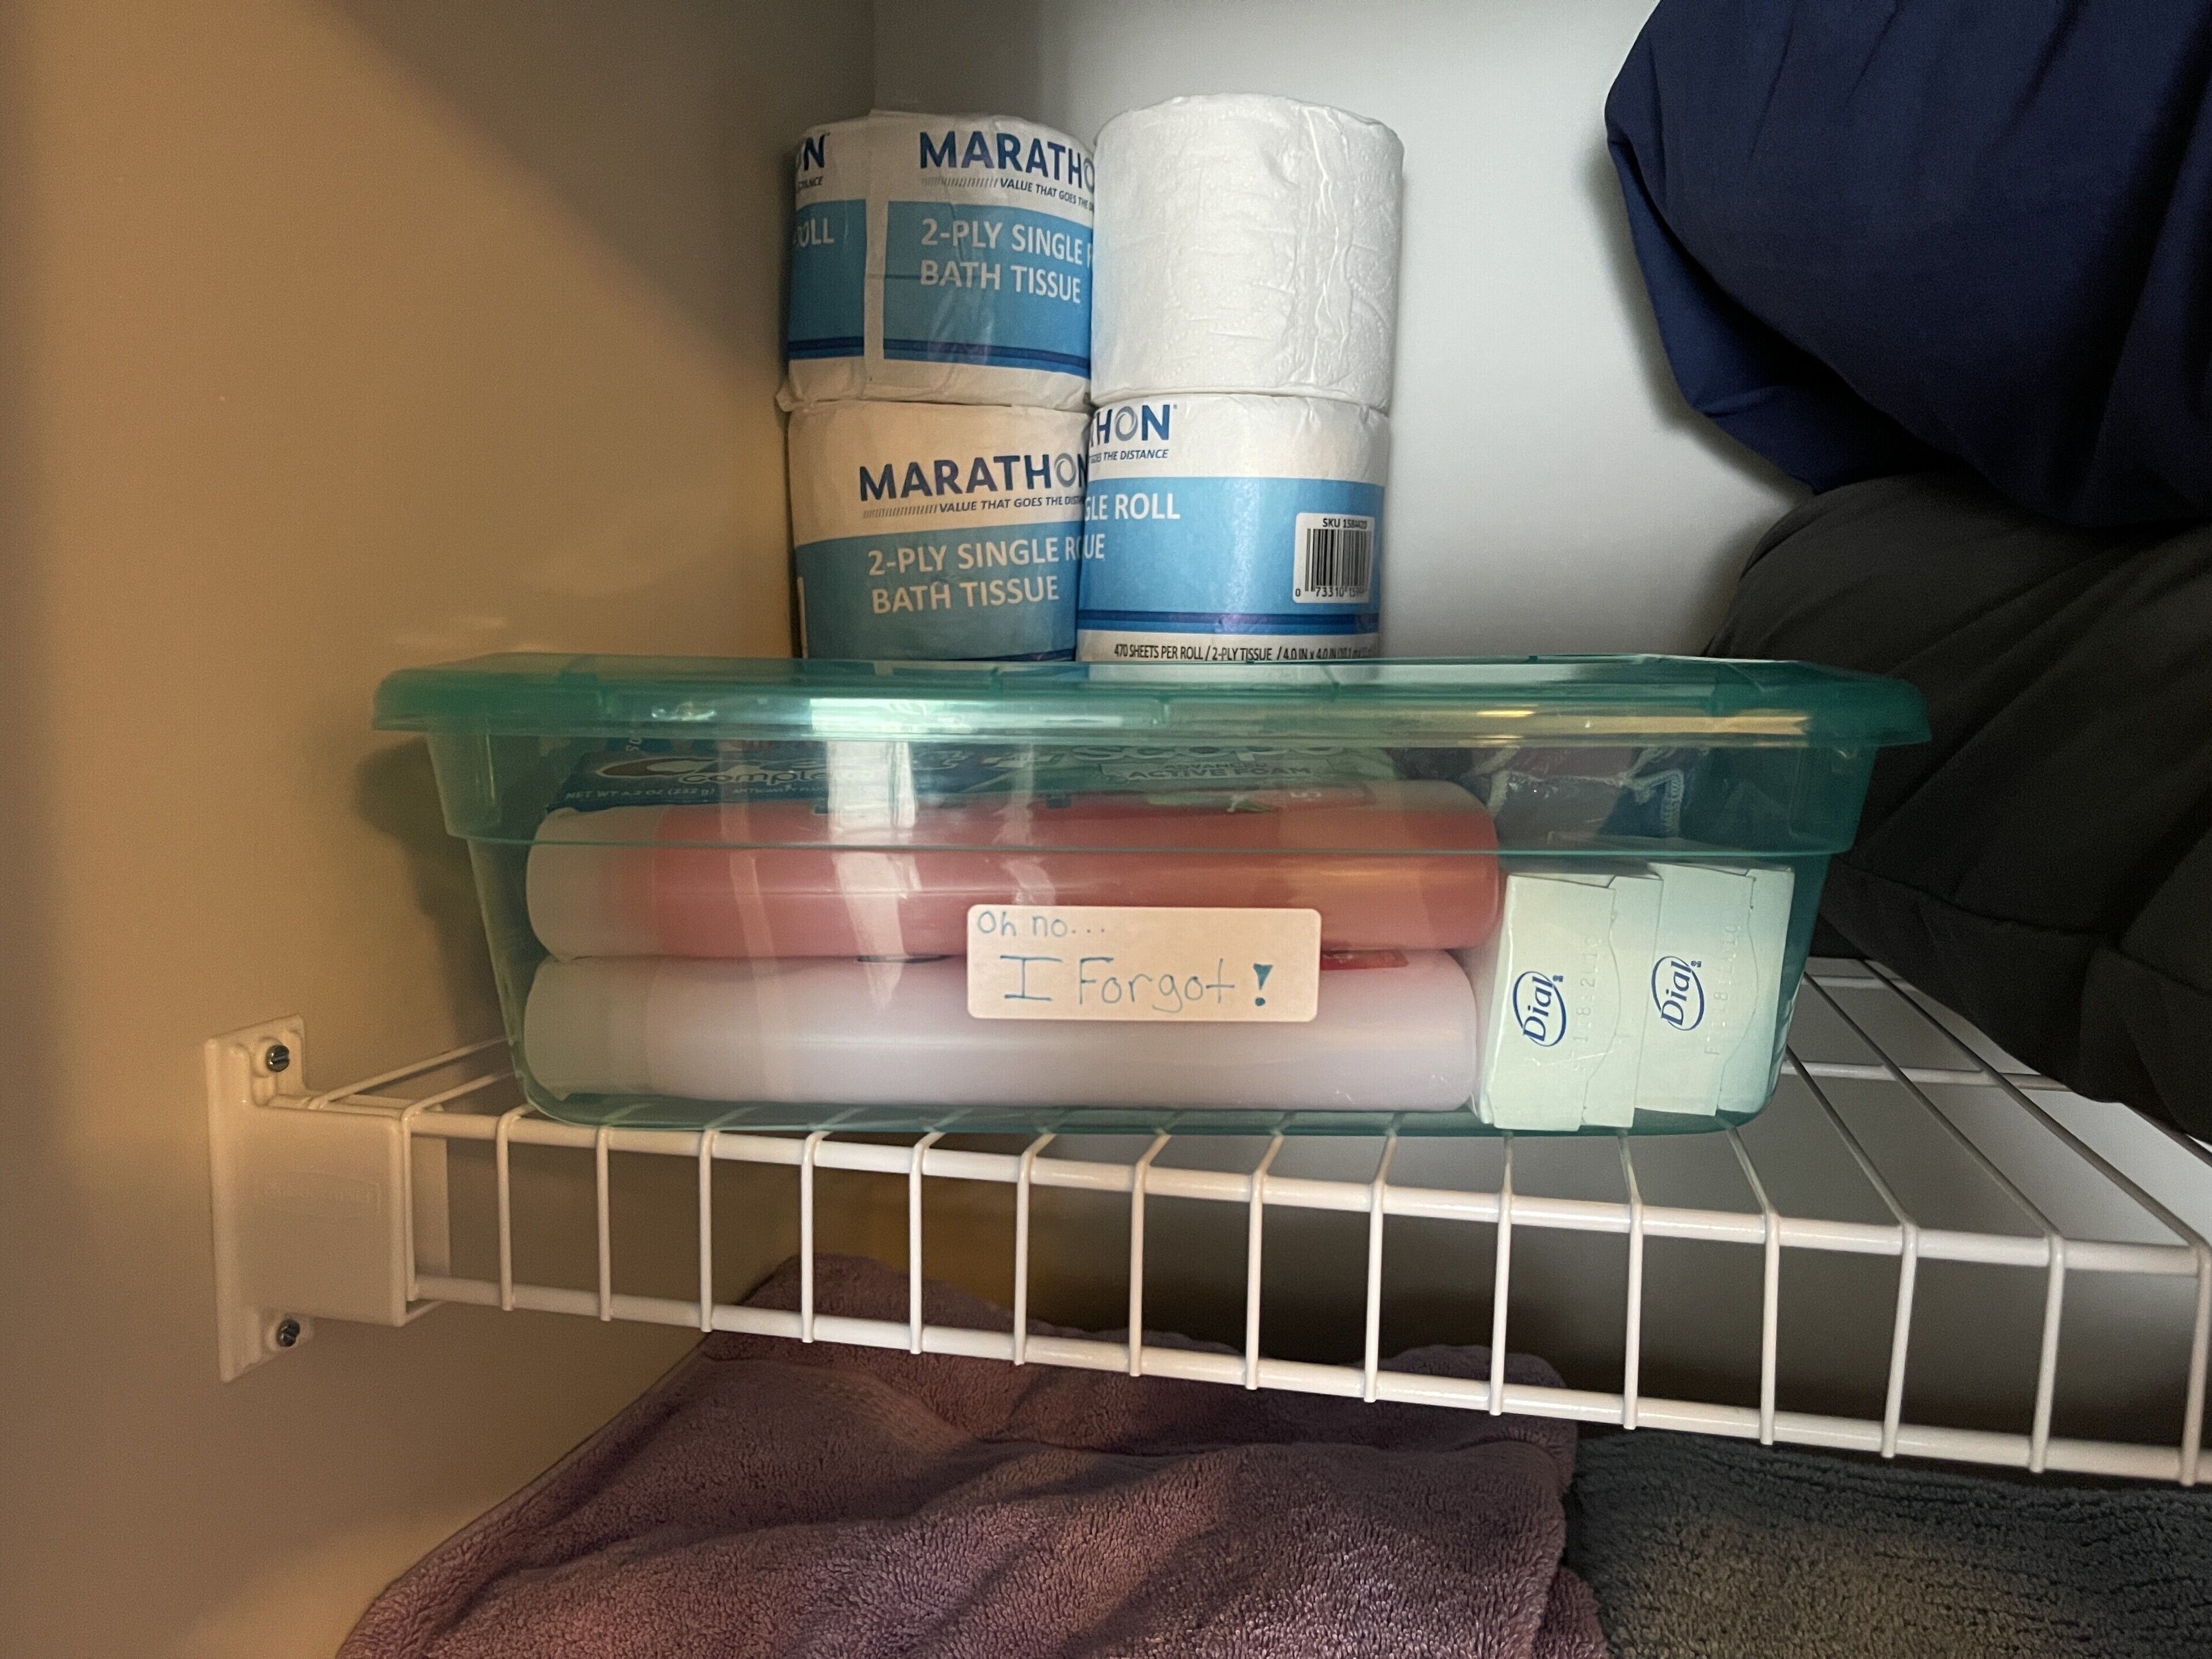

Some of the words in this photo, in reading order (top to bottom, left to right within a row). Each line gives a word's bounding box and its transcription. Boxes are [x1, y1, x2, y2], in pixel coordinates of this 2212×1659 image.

[796, 134, 826, 171] N
[1000, 177, 1033, 192] VALUE
[1036, 183, 1058, 198] THAT
[1058, 190, 1077, 204] GOES
[794, 217, 835, 247] OLL
[921, 218, 1002, 250] 2-PLY
[1012, 223, 1083, 266] SINGLE
[921, 260, 1001, 290] BATH
[1010, 264, 1081, 304] TISSUE
[1090, 404, 1171, 448] HON
[1104, 451, 1118, 461] THE
[1120, 449, 1169, 460] DISTANCE
[939, 501, 978, 513] VALUE
[980, 498, 1010, 510] THAT
[1013, 497, 1043, 508] GOES
[1046, 496, 1063, 506] THE
[1115, 493, 1181, 520] ROLL
[1322, 518, 1340, 528] SKU
[868, 544, 948, 576] 2-PLY
[958, 537, 1059, 570] SINGLE
[872, 582, 950, 615] BATH
[959, 575, 1060, 608] TISSUE
[1113, 643, 1128, 657] 470
[1129, 644, 1159, 658] SHEETS
[1161, 645, 1178, 659] PER
[1180, 646, 1203, 660] ROLL
[1212, 646, 1238, 661] 2-PLY
[1240, 647, 1272, 661] TISSUE
[1128, 768, 1226, 778] ACTIVE
[1234, 767, 1310, 776] FOAM
[976, 911, 1017, 938] Oh
[999, 955, 1064, 1002] I
[1659, 960, 1694, 1027] Dial
[1521, 975, 1555, 1043] Dial
